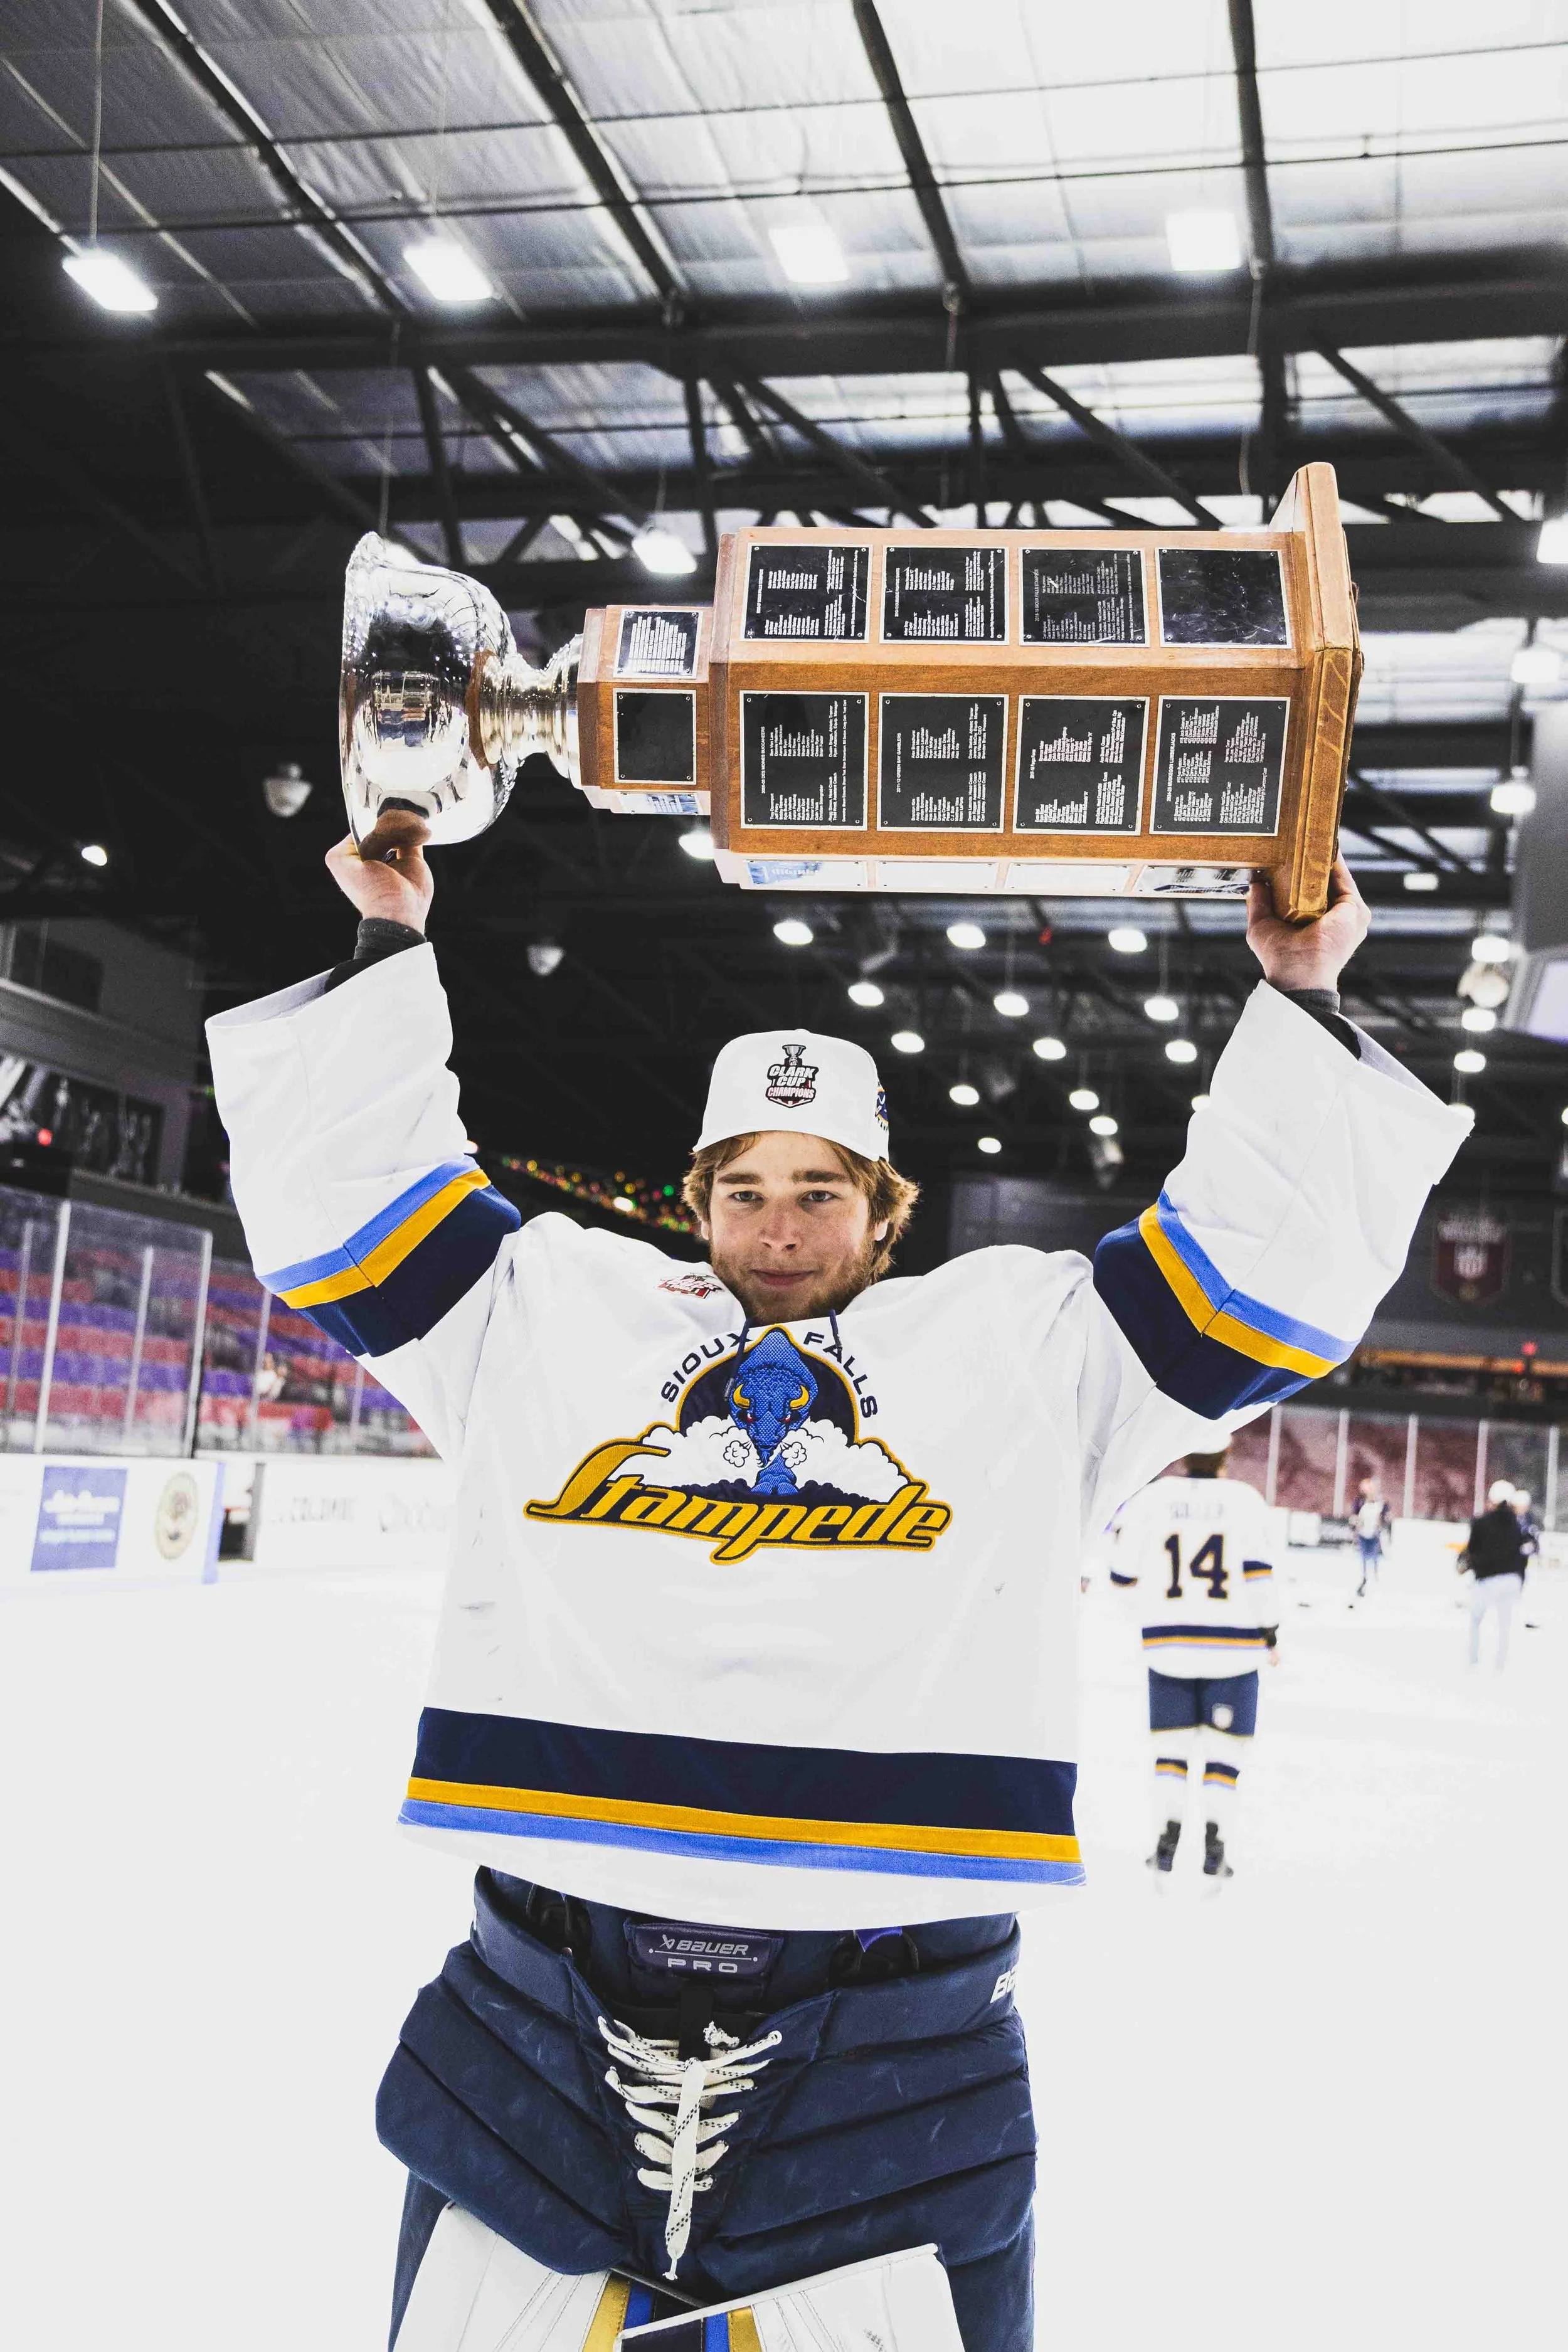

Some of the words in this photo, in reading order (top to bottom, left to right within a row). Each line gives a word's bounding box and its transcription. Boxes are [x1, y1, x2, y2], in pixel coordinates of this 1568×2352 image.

[769, 1065, 815, 1078] CLARK
[776, 1076, 806, 1087] CUP
[767, 1086, 815, 1098] CHAMPIONS
[660, 1332, 753, 1403] SIOUX
[803, 1331, 878, 1418] FALLS
[528, 1443, 947, 1560] Stampede
[1164, 1533, 1229, 1599] 14
[667, 1957, 738, 1974] PRO
